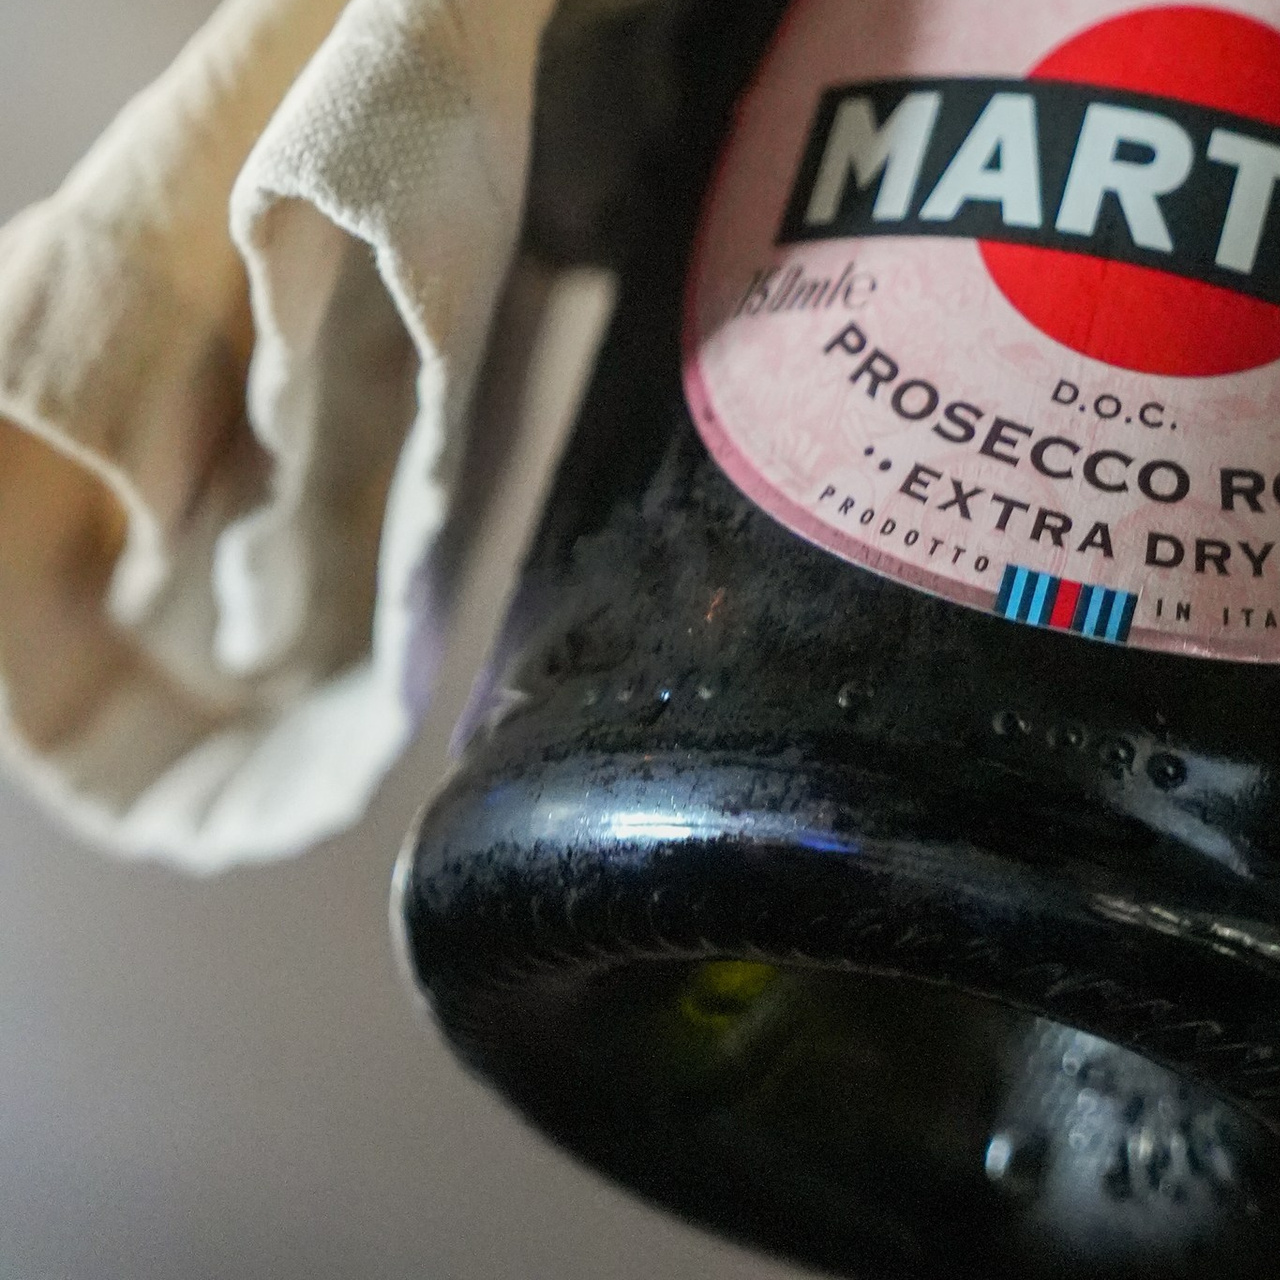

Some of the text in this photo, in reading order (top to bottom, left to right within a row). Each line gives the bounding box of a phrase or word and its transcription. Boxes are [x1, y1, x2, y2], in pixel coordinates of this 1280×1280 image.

[823, 320, 1191, 504] PROSECCO
[1050, 378, 1178, 431] D.O.C.
[818, 483, 990, 574] PRODOTTO
[1154, 598, 1192, 622] IN
[898, 461, 1275, 578] EXTRA DRY
